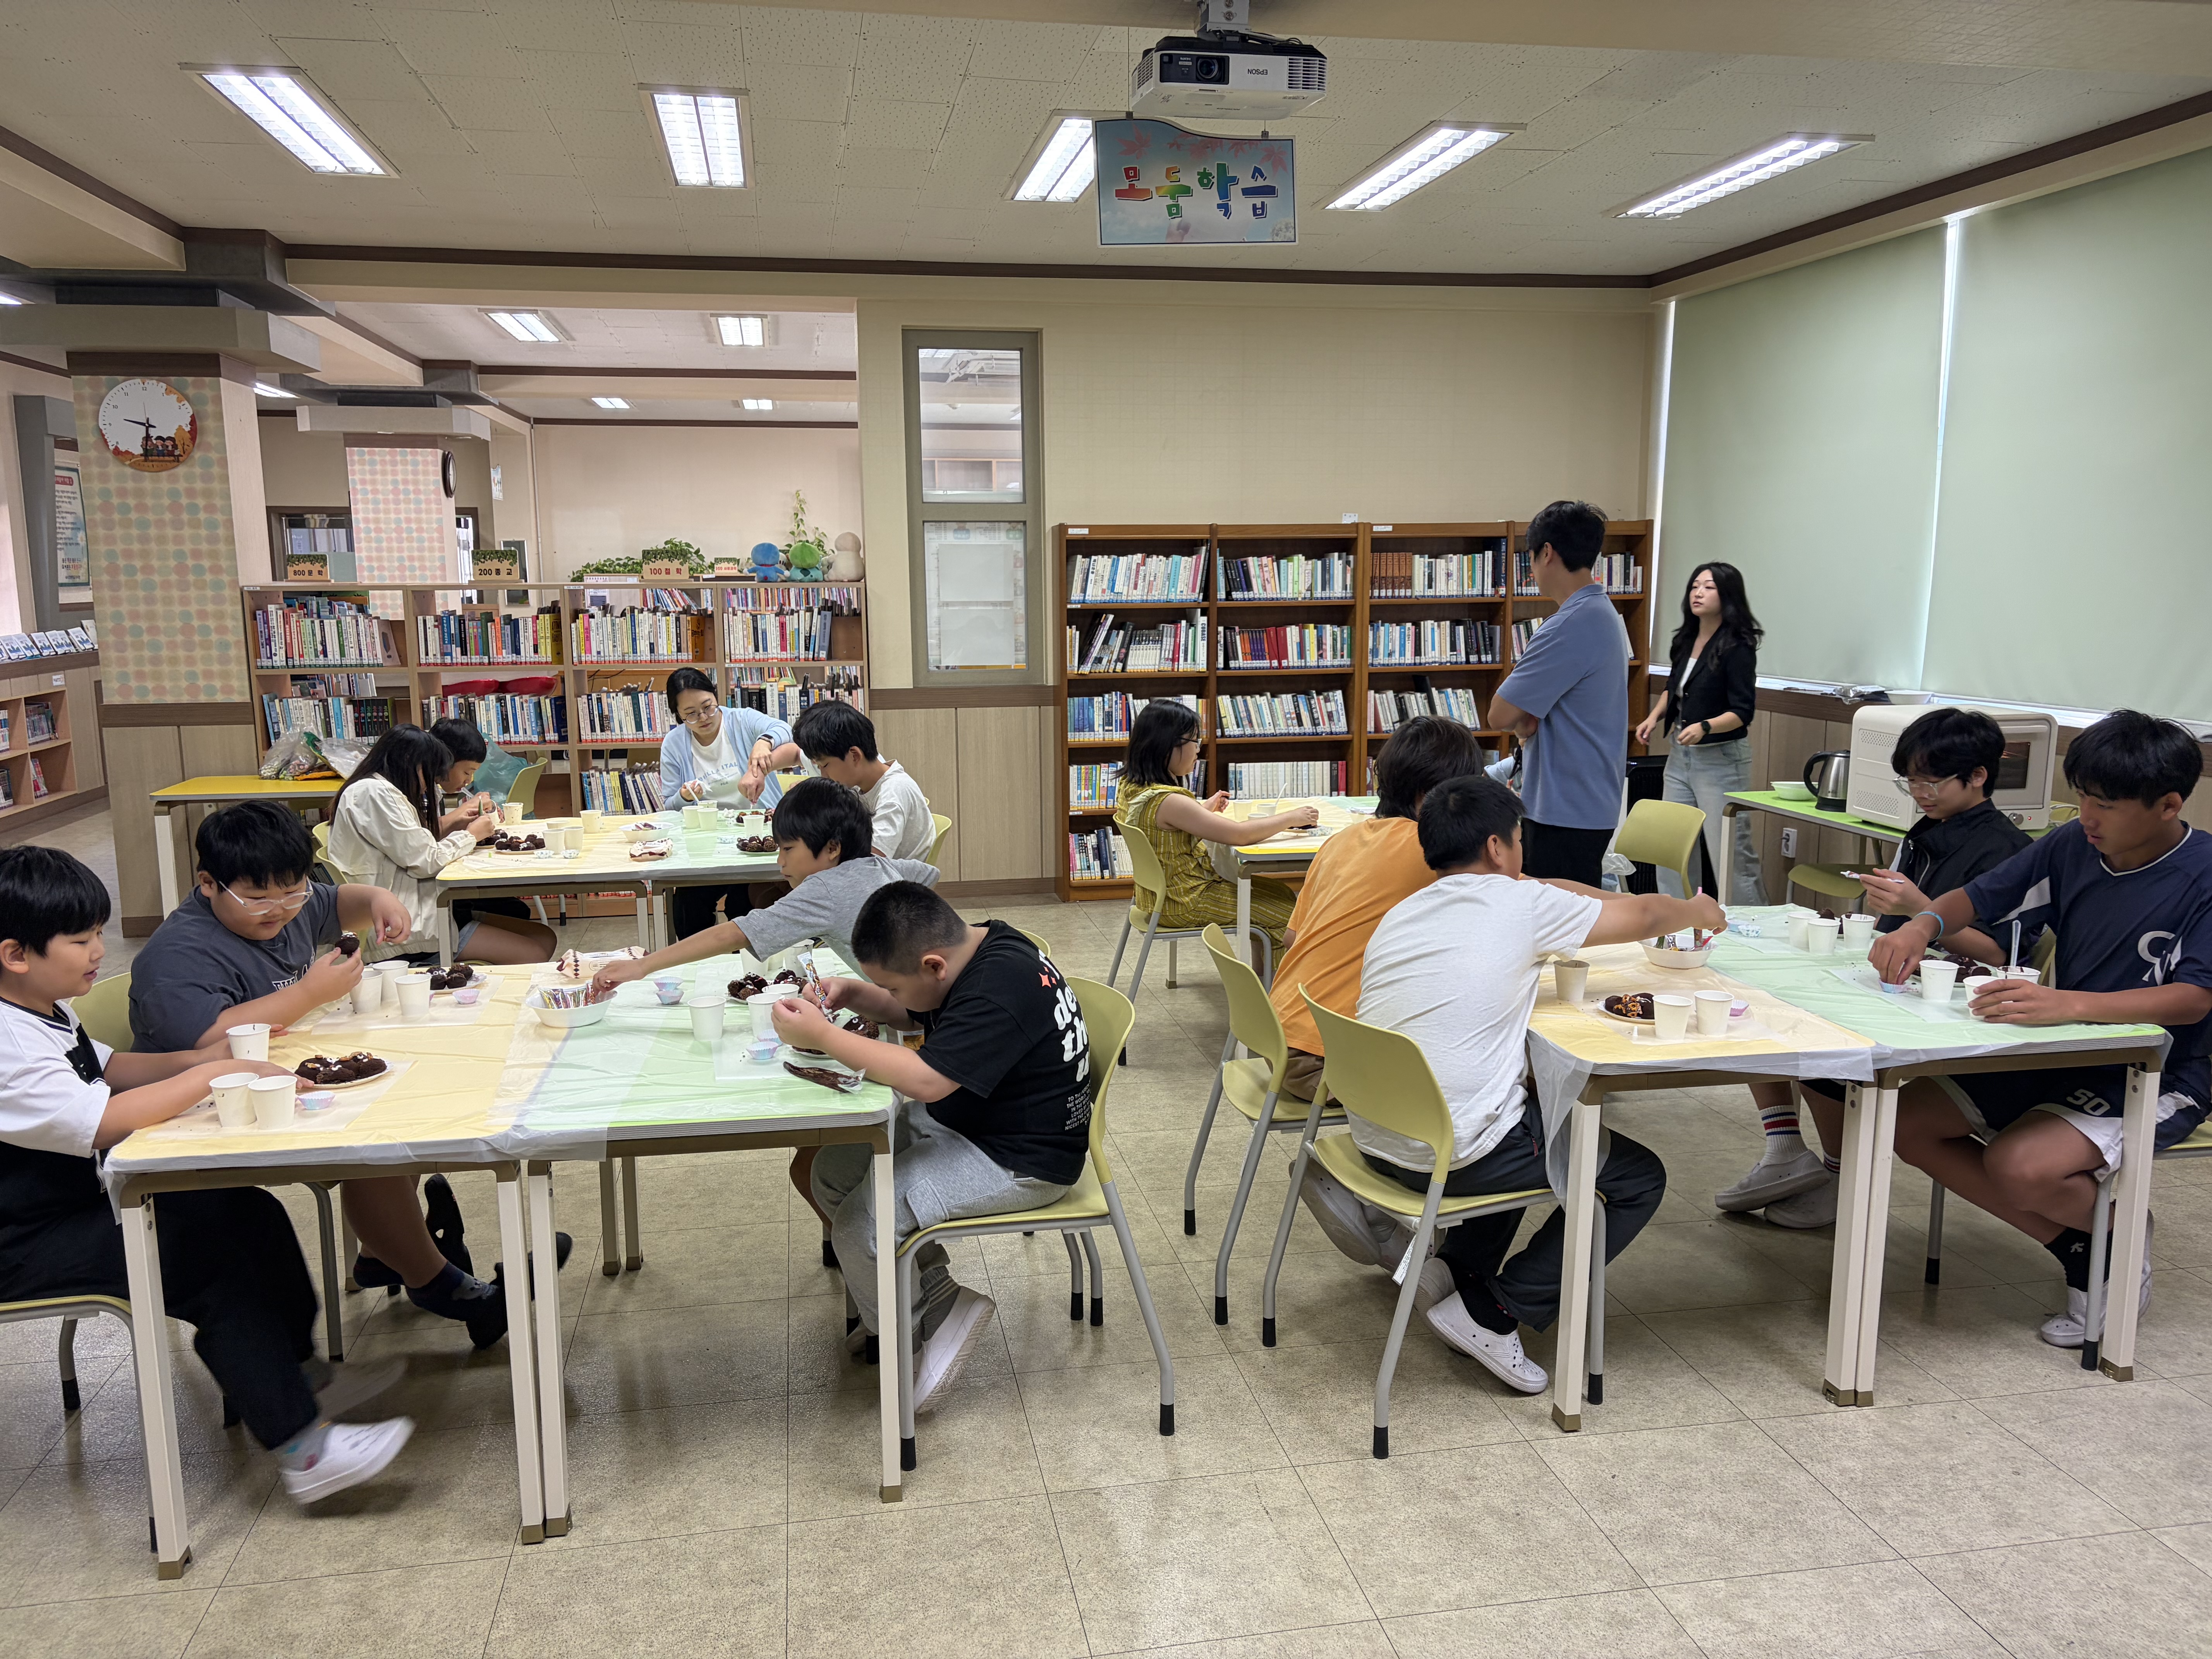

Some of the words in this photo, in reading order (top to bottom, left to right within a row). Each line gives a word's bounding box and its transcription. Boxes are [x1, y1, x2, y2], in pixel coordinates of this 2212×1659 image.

[1115, 162, 1278, 220] 모둠학습
[1071, 1108, 1083, 1118] LOVED
[1065, 1121, 1079, 1130] NICEST
[1066, 1117, 1077, 1125] WITH
